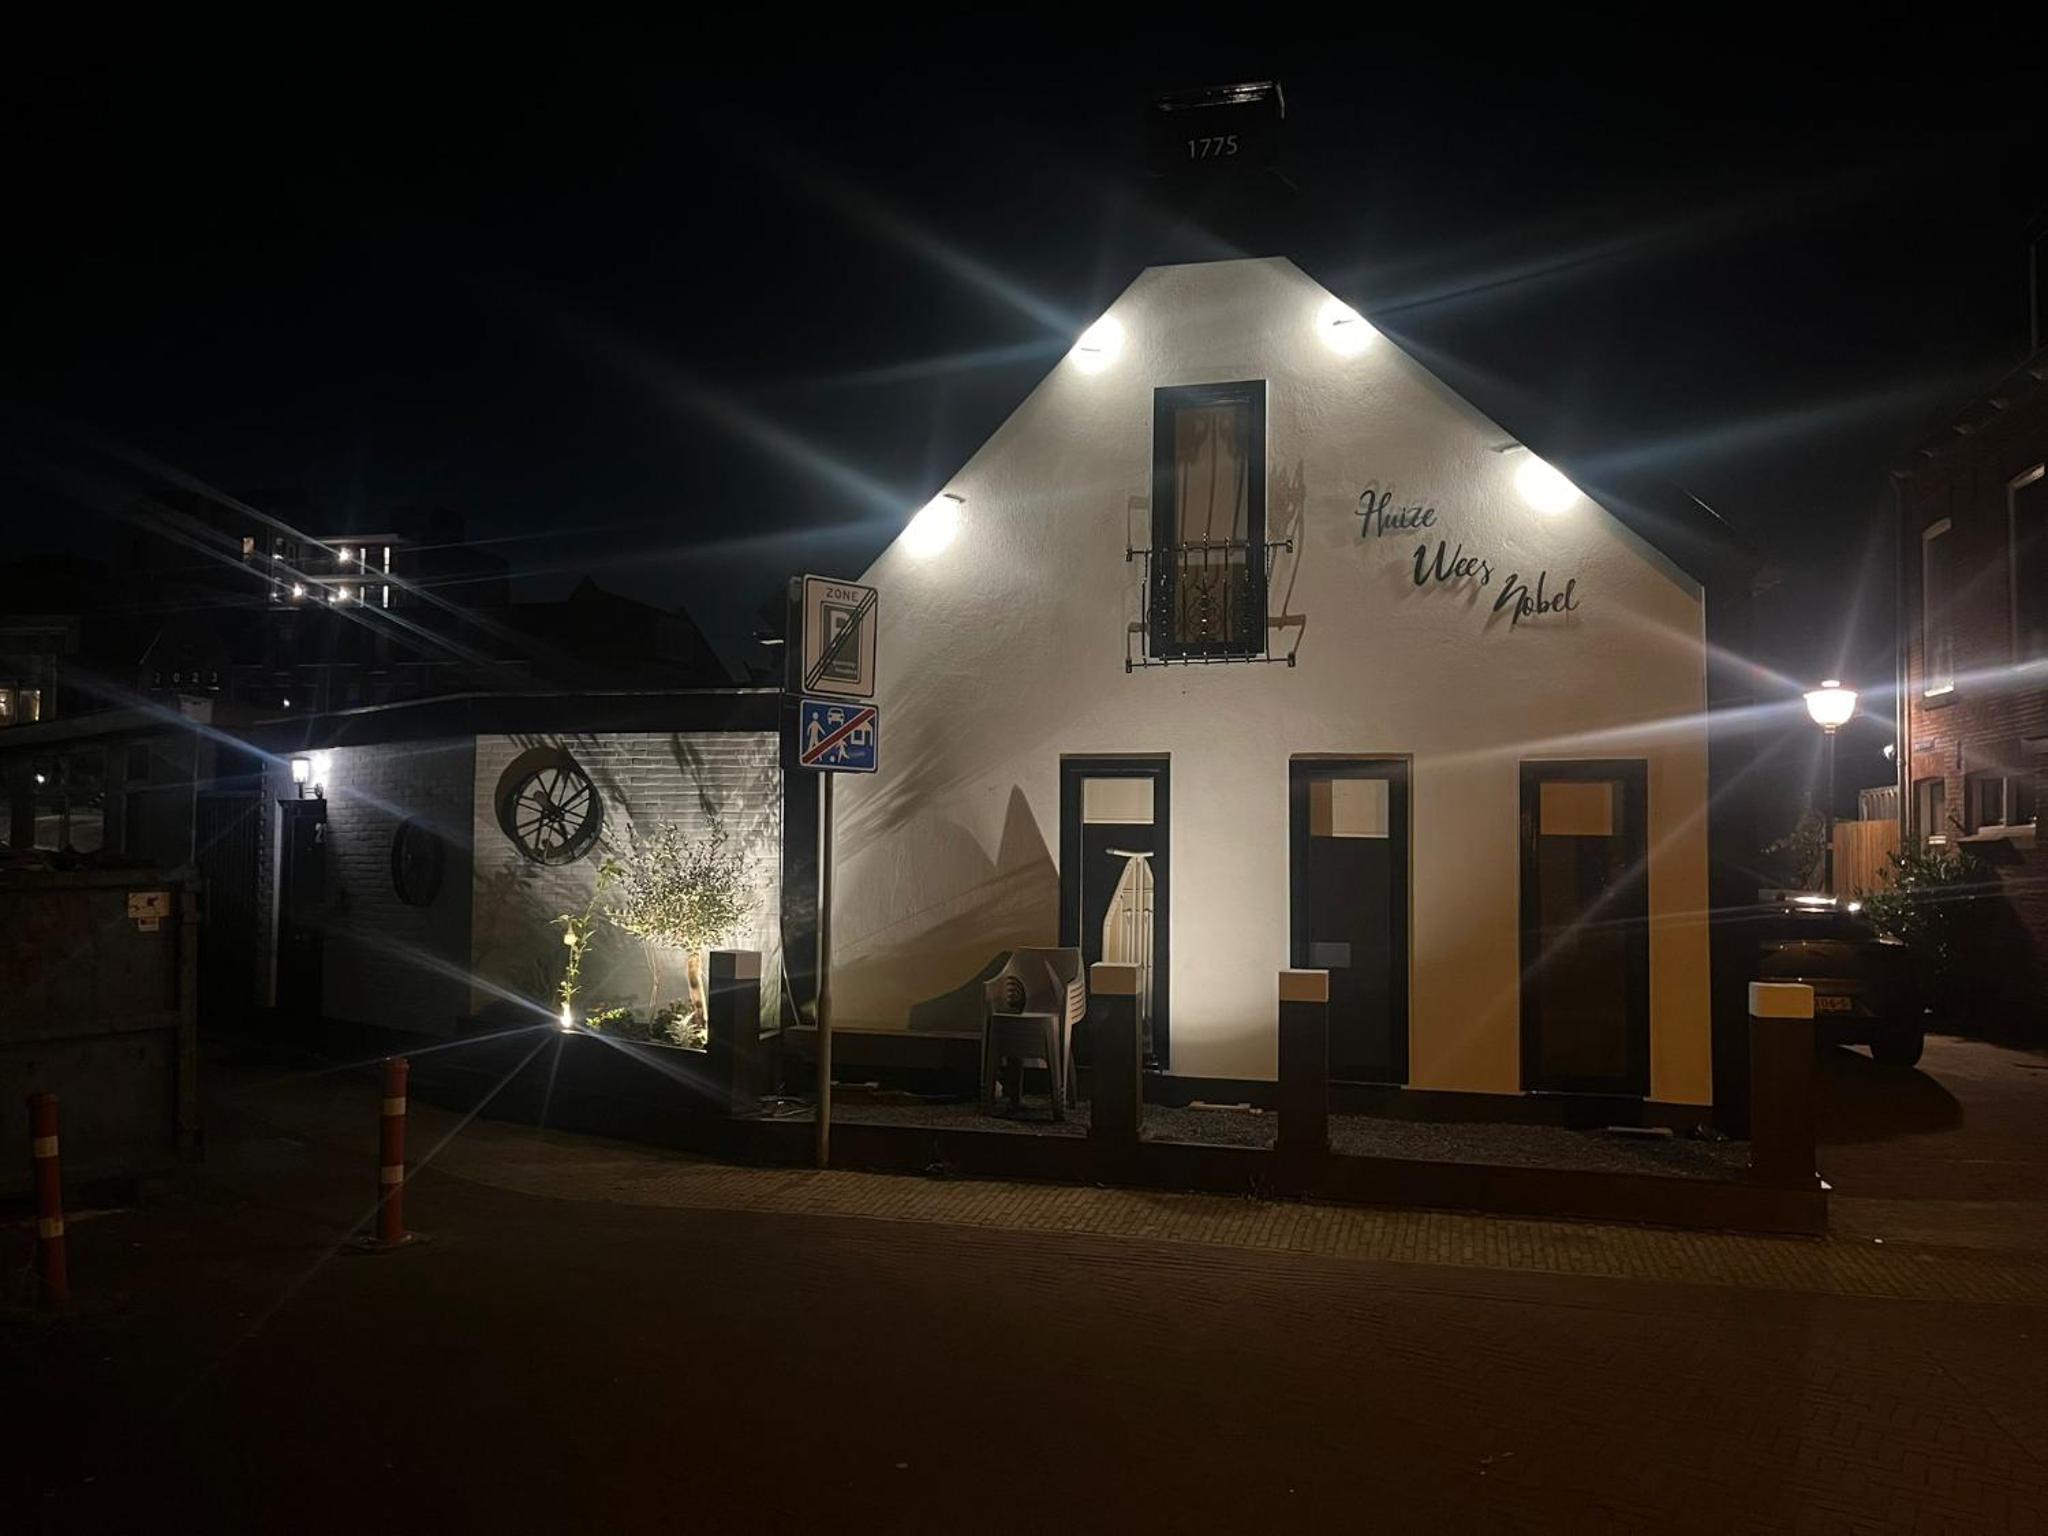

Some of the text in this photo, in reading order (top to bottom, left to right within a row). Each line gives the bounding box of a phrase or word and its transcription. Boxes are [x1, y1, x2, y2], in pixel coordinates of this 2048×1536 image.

[1187, 135, 1238, 159] 1775
[1355, 489, 1438, 538] Huize
[1413, 540, 1495, 587] Wees
[826, 587, 860, 603] ZONE
[1493, 571, 1580, 625] Nobel
